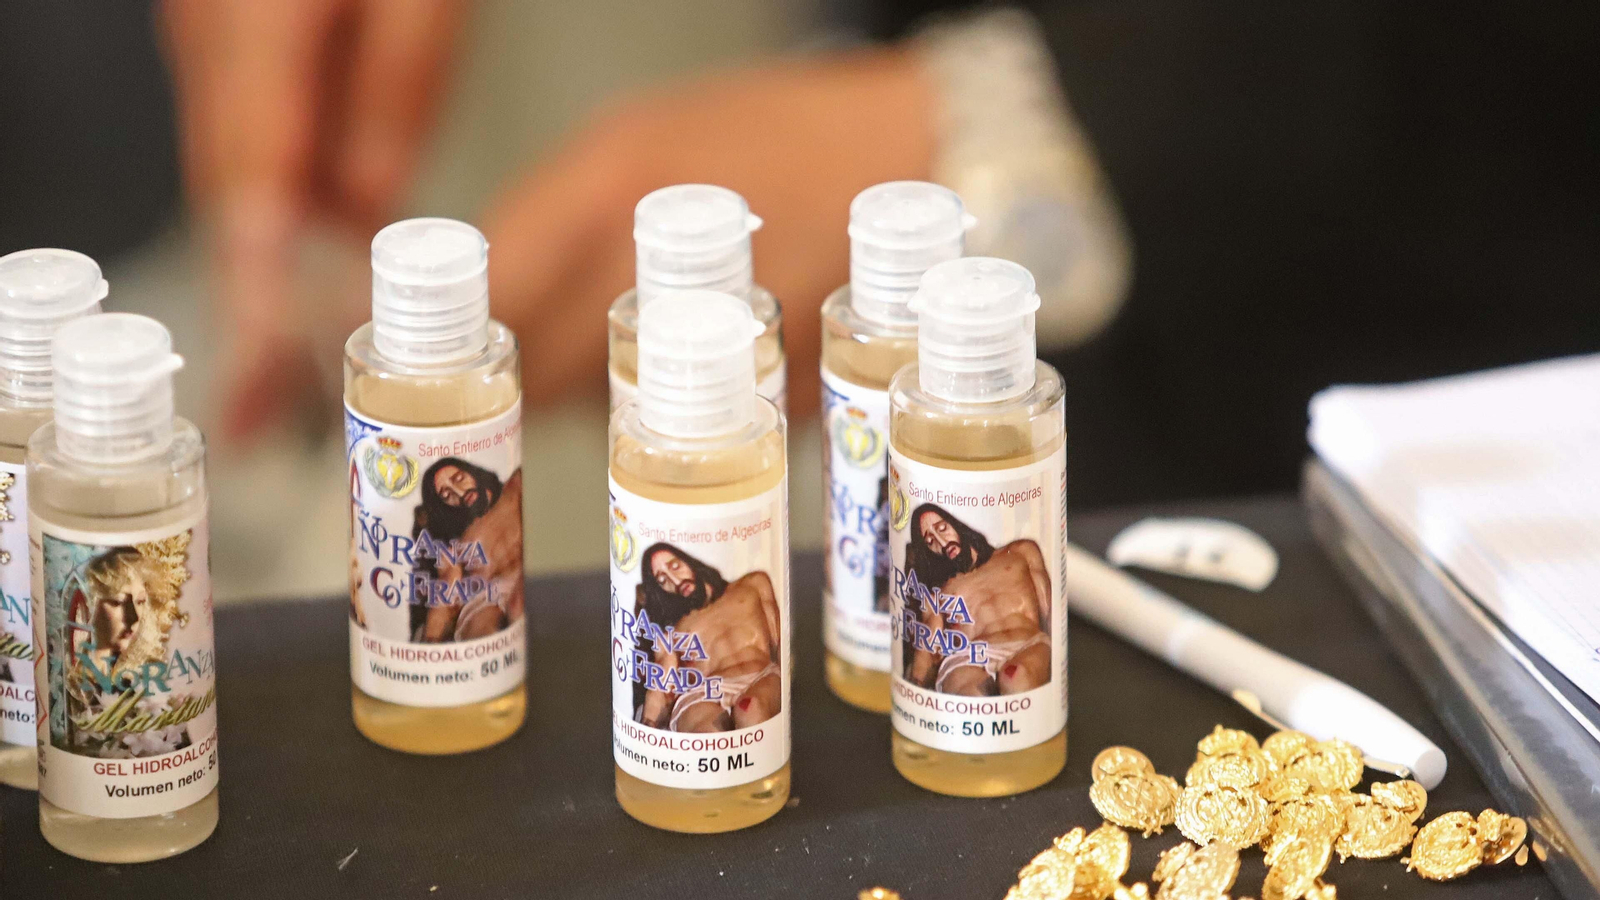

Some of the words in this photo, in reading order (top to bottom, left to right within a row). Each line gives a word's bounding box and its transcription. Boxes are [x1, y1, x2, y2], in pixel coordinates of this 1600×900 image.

[418, 443, 450, 457] Santo
[453, 437, 491, 455] Entierro
[493, 432, 503, 446] de
[908, 481, 934, 502] Santo
[936, 490, 978, 507] Entierro
[981, 493, 995, 507] de
[997, 486, 1042, 508] Algeciras
[638, 522, 666, 541] Santo
[669, 529, 712, 543] Entierro
[715, 529, 729, 542] de
[731, 518, 772, 541] Algeciras
[362, 637, 386, 657] GEL
[369, 660, 430, 684] Volumen
[435, 670, 474, 684] neto:
[480, 659, 499, 678] 50
[502, 648, 518, 669] ML
[620, 720, 764, 751] HIDROALCOHOLICO
[919, 716, 954, 735] neto:
[961, 721, 984, 737] 50
[991, 719, 1020, 737] ML
[93, 762, 127, 776] GEL
[652, 758, 690, 773] neto:
[697, 757, 720, 773] 50
[727, 752, 755, 771] ML
[105, 780, 173, 798] Volumen
[177, 766, 205, 788] neto:
